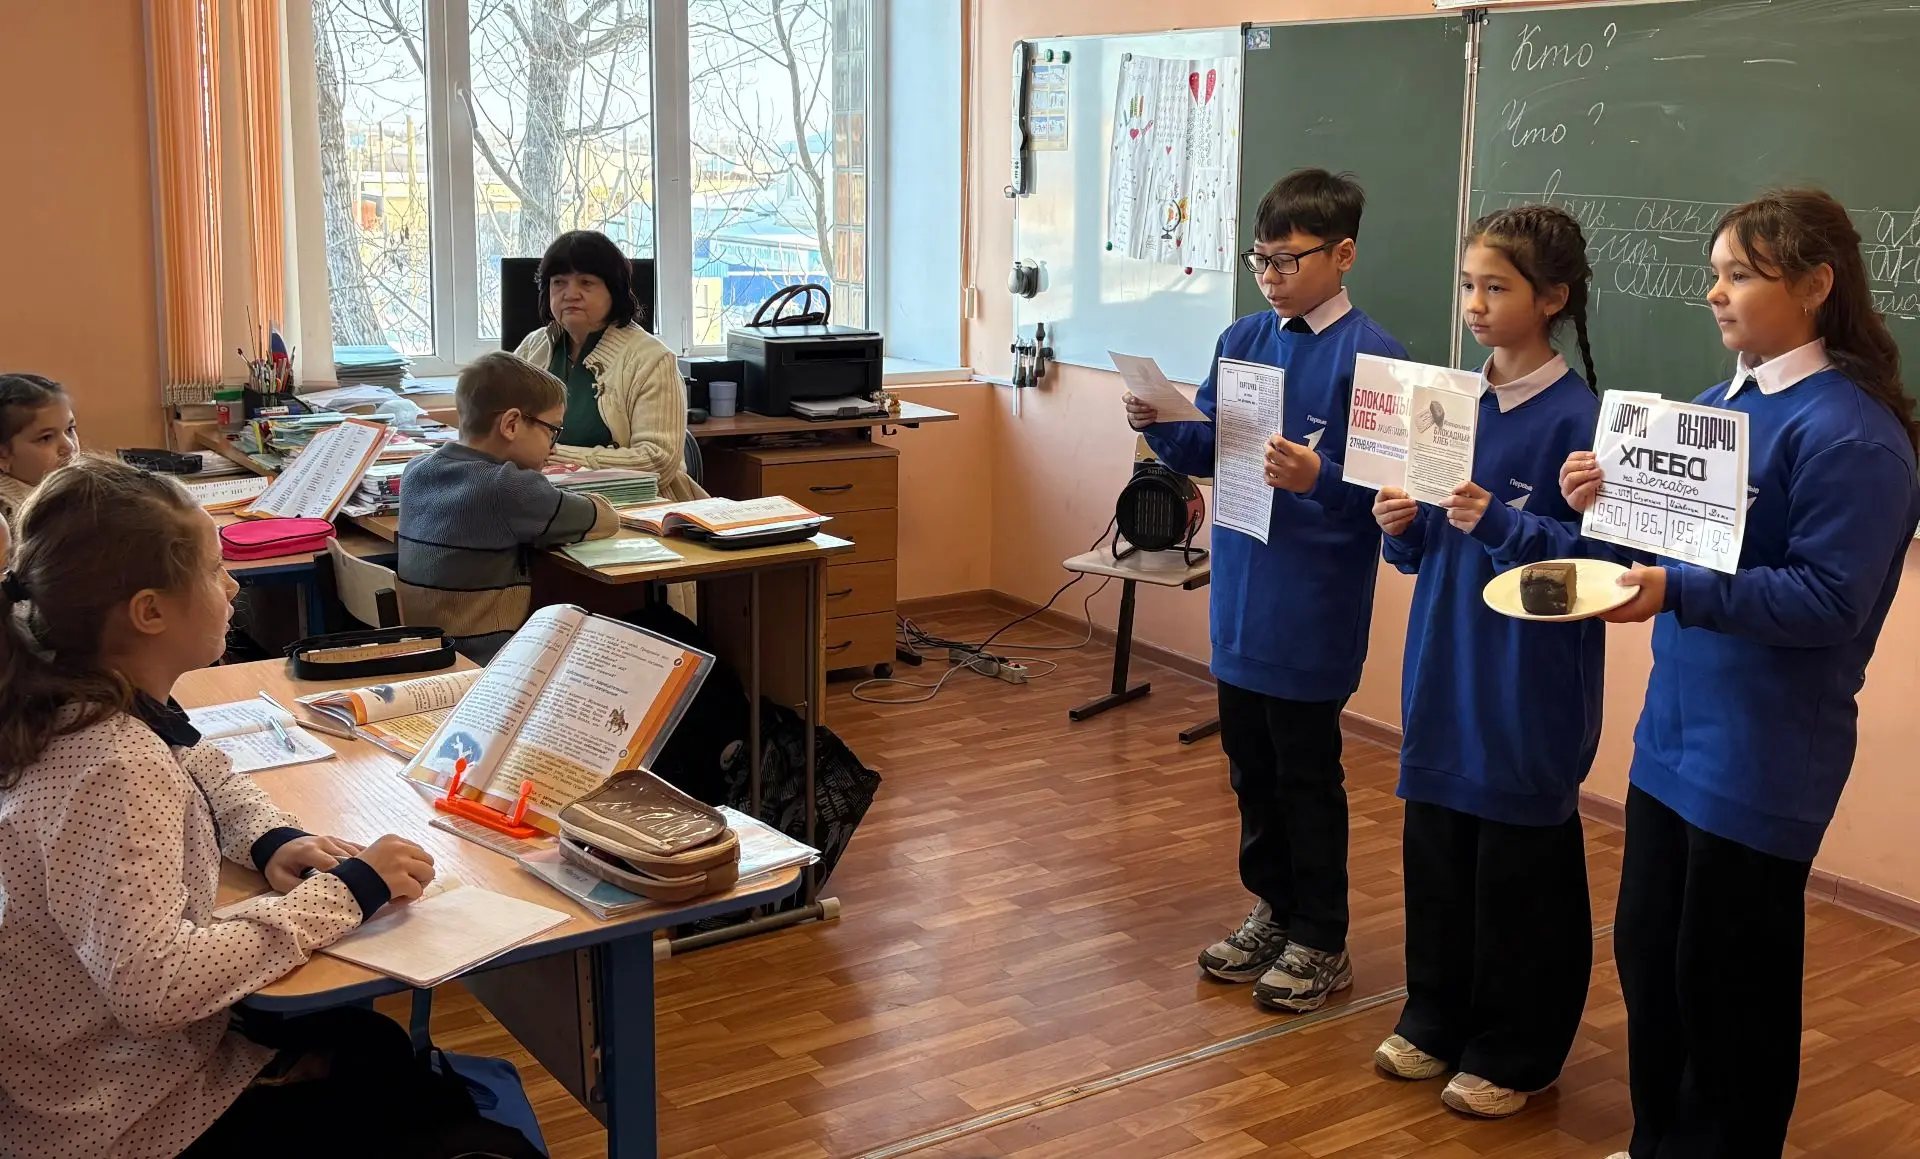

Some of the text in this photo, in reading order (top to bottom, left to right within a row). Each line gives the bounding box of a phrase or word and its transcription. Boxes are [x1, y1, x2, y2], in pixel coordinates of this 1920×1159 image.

[1351, 409, 1377, 431] ХЛЕБ
[1610, 402, 1736, 452] НОРМА ВЫДАЧИ
[1618, 443, 1708, 482] ХЛЕБА
